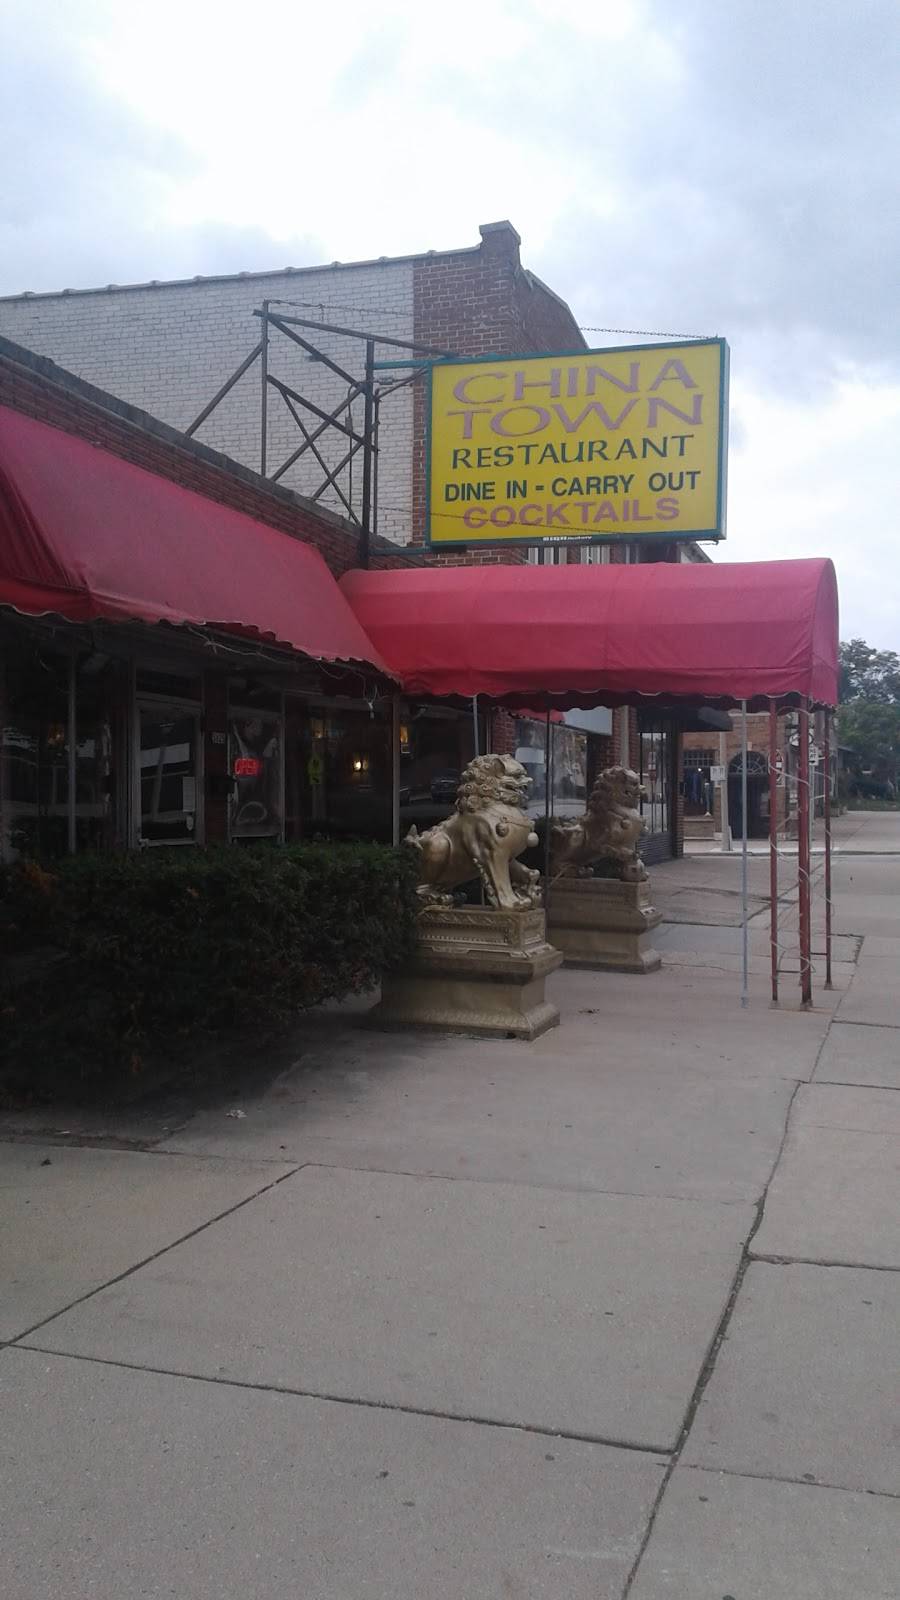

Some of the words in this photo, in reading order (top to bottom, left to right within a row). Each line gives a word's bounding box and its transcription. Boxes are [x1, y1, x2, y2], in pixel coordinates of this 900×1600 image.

[452, 358, 698, 405] CHINA
[447, 394, 704, 440] TOWN
[452, 434, 694, 470] RESTAURANT
[444, 481, 496, 502] DINE
[506, 479, 528, 499] IN
[551, 474, 634, 497] CARRY
[648, 471, 701, 492] OUT
[463, 497, 681, 529] COCKTAILS
